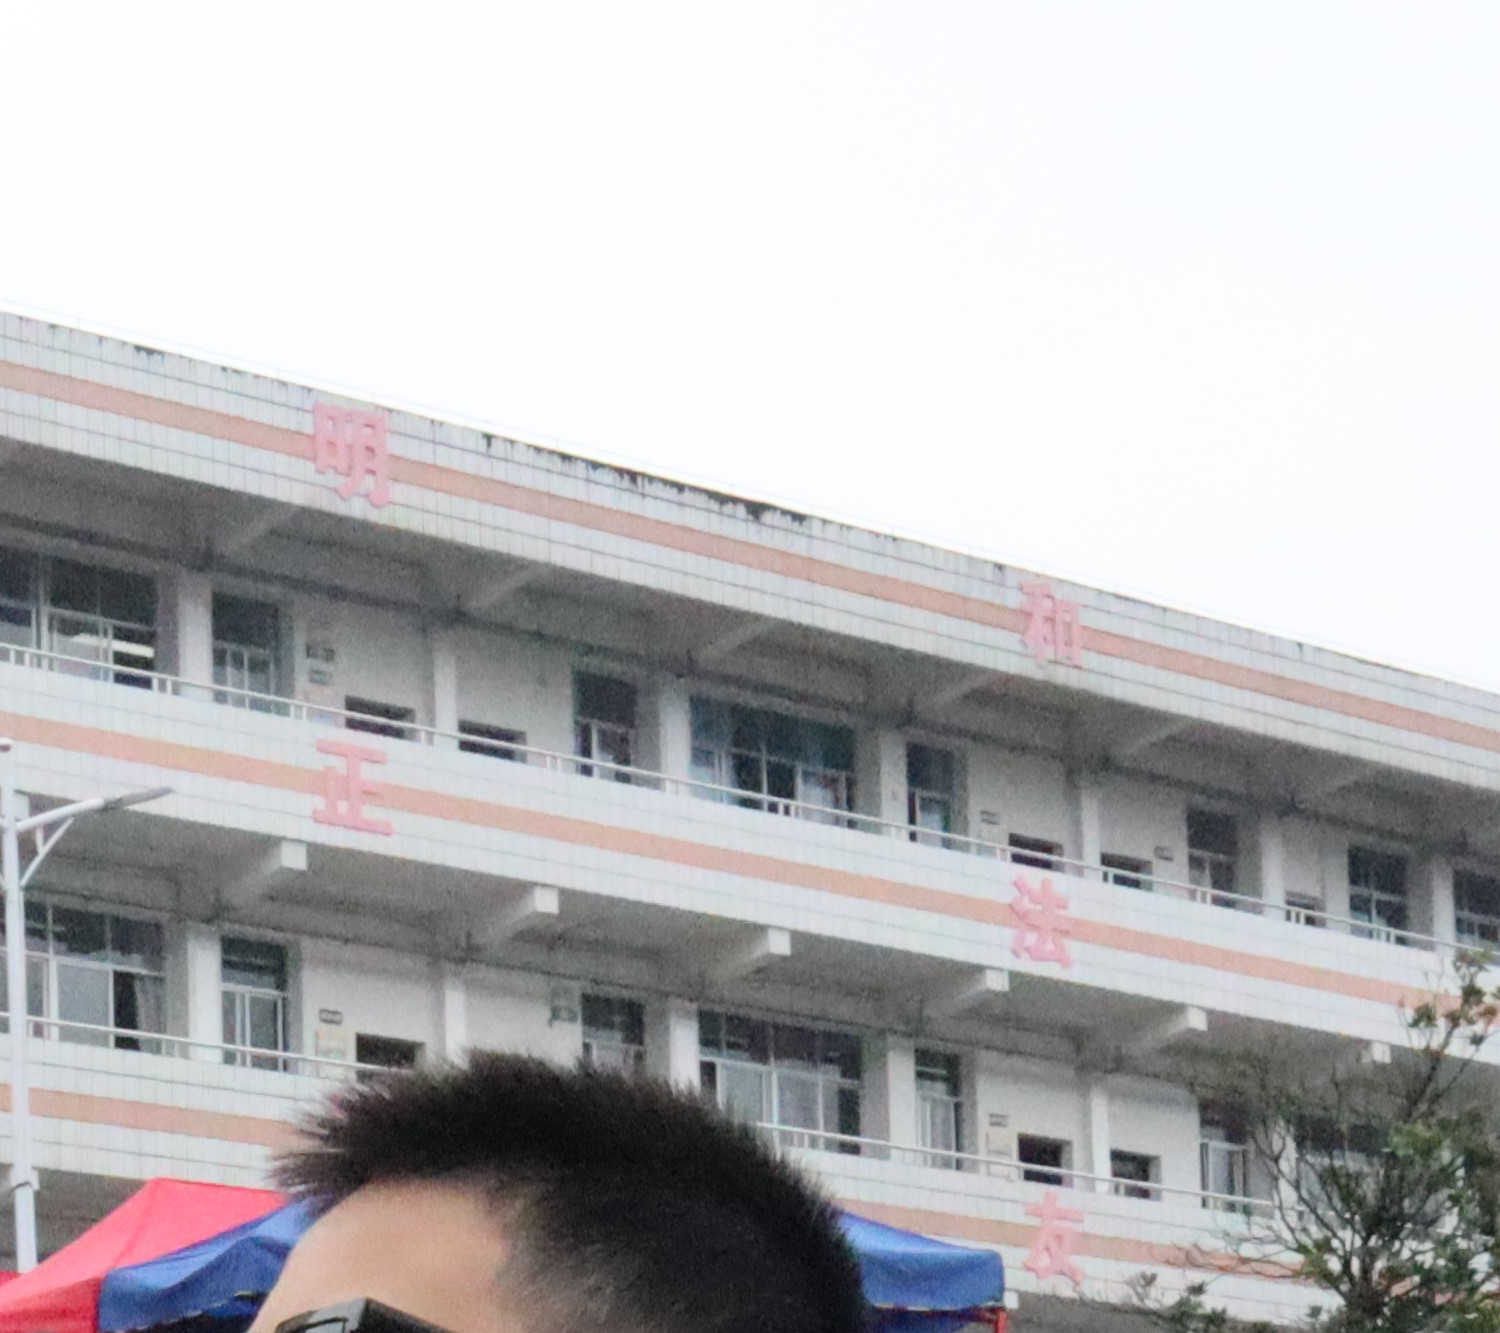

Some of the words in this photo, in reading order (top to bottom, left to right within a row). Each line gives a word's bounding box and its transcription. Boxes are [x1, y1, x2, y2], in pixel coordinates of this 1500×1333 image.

[313, 400, 390, 508] 明
[1020, 582, 1083, 669] 和
[313, 739, 393, 835] 正
[1010, 874, 1074, 970] 法
[1023, 1190, 1084, 1284] 友
